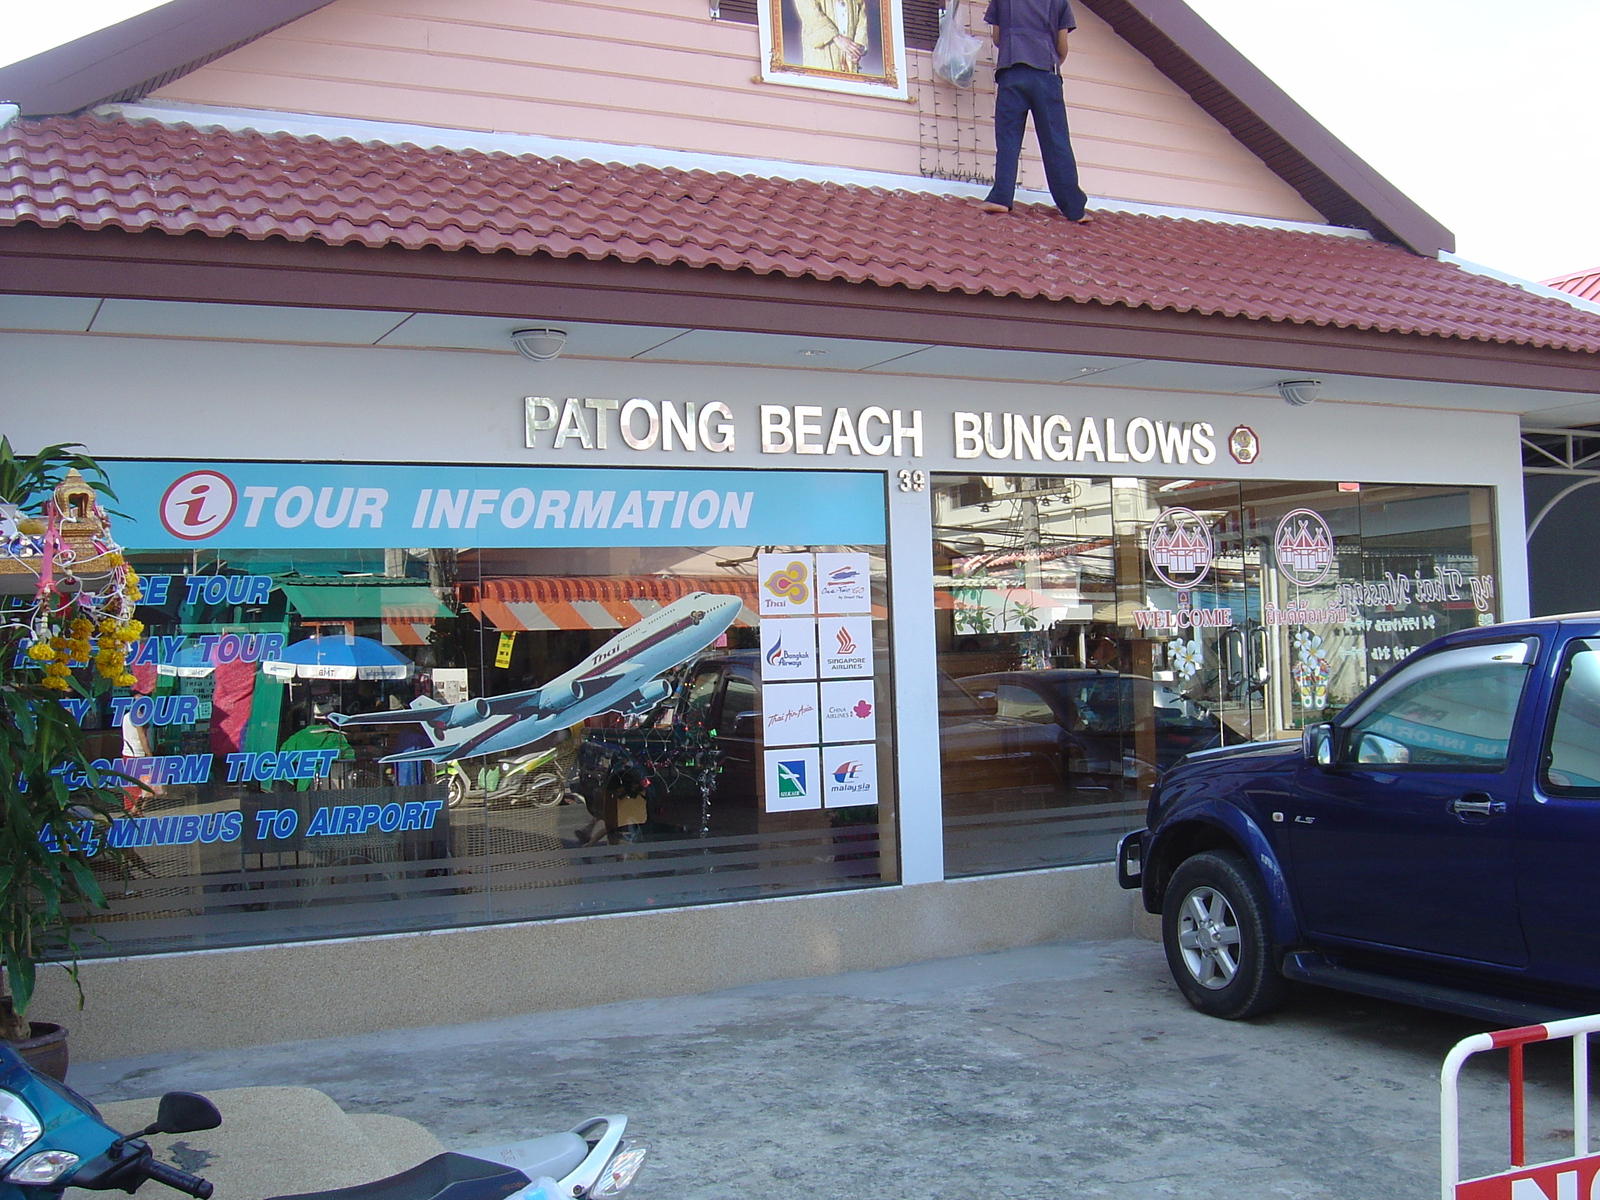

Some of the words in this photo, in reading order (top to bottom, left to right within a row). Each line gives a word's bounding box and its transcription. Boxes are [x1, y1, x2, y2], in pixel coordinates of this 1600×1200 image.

[524, 396, 736, 453] PATONG
[760, 404, 923, 457] BEACH
[954, 411, 1217, 465] BUNGALOWS
[898, 469, 925, 492] 39
[243, 485, 389, 529] TOUR
[412, 488, 755, 530] INFORMATION
[185, 575, 273, 605] TOUR
[765, 599, 786, 608] Thai
[1265, 600, 1348, 626] ยินดีต้อนรับ
[1133, 608, 1232, 630] WELCOME
[199, 633, 286, 664] TOUR
[592, 644, 620, 666] Thai
[784, 650, 809, 660] Bangkok
[778, 657, 802, 667] Airways
[110, 695, 200, 727] TOUR
[226, 749, 340, 782] TICKET
[831, 782, 871, 793] malaysia
[107, 811, 243, 849] MINIBUS
[256, 808, 298, 840] TO
[306, 801, 444, 837] AIRPORT
